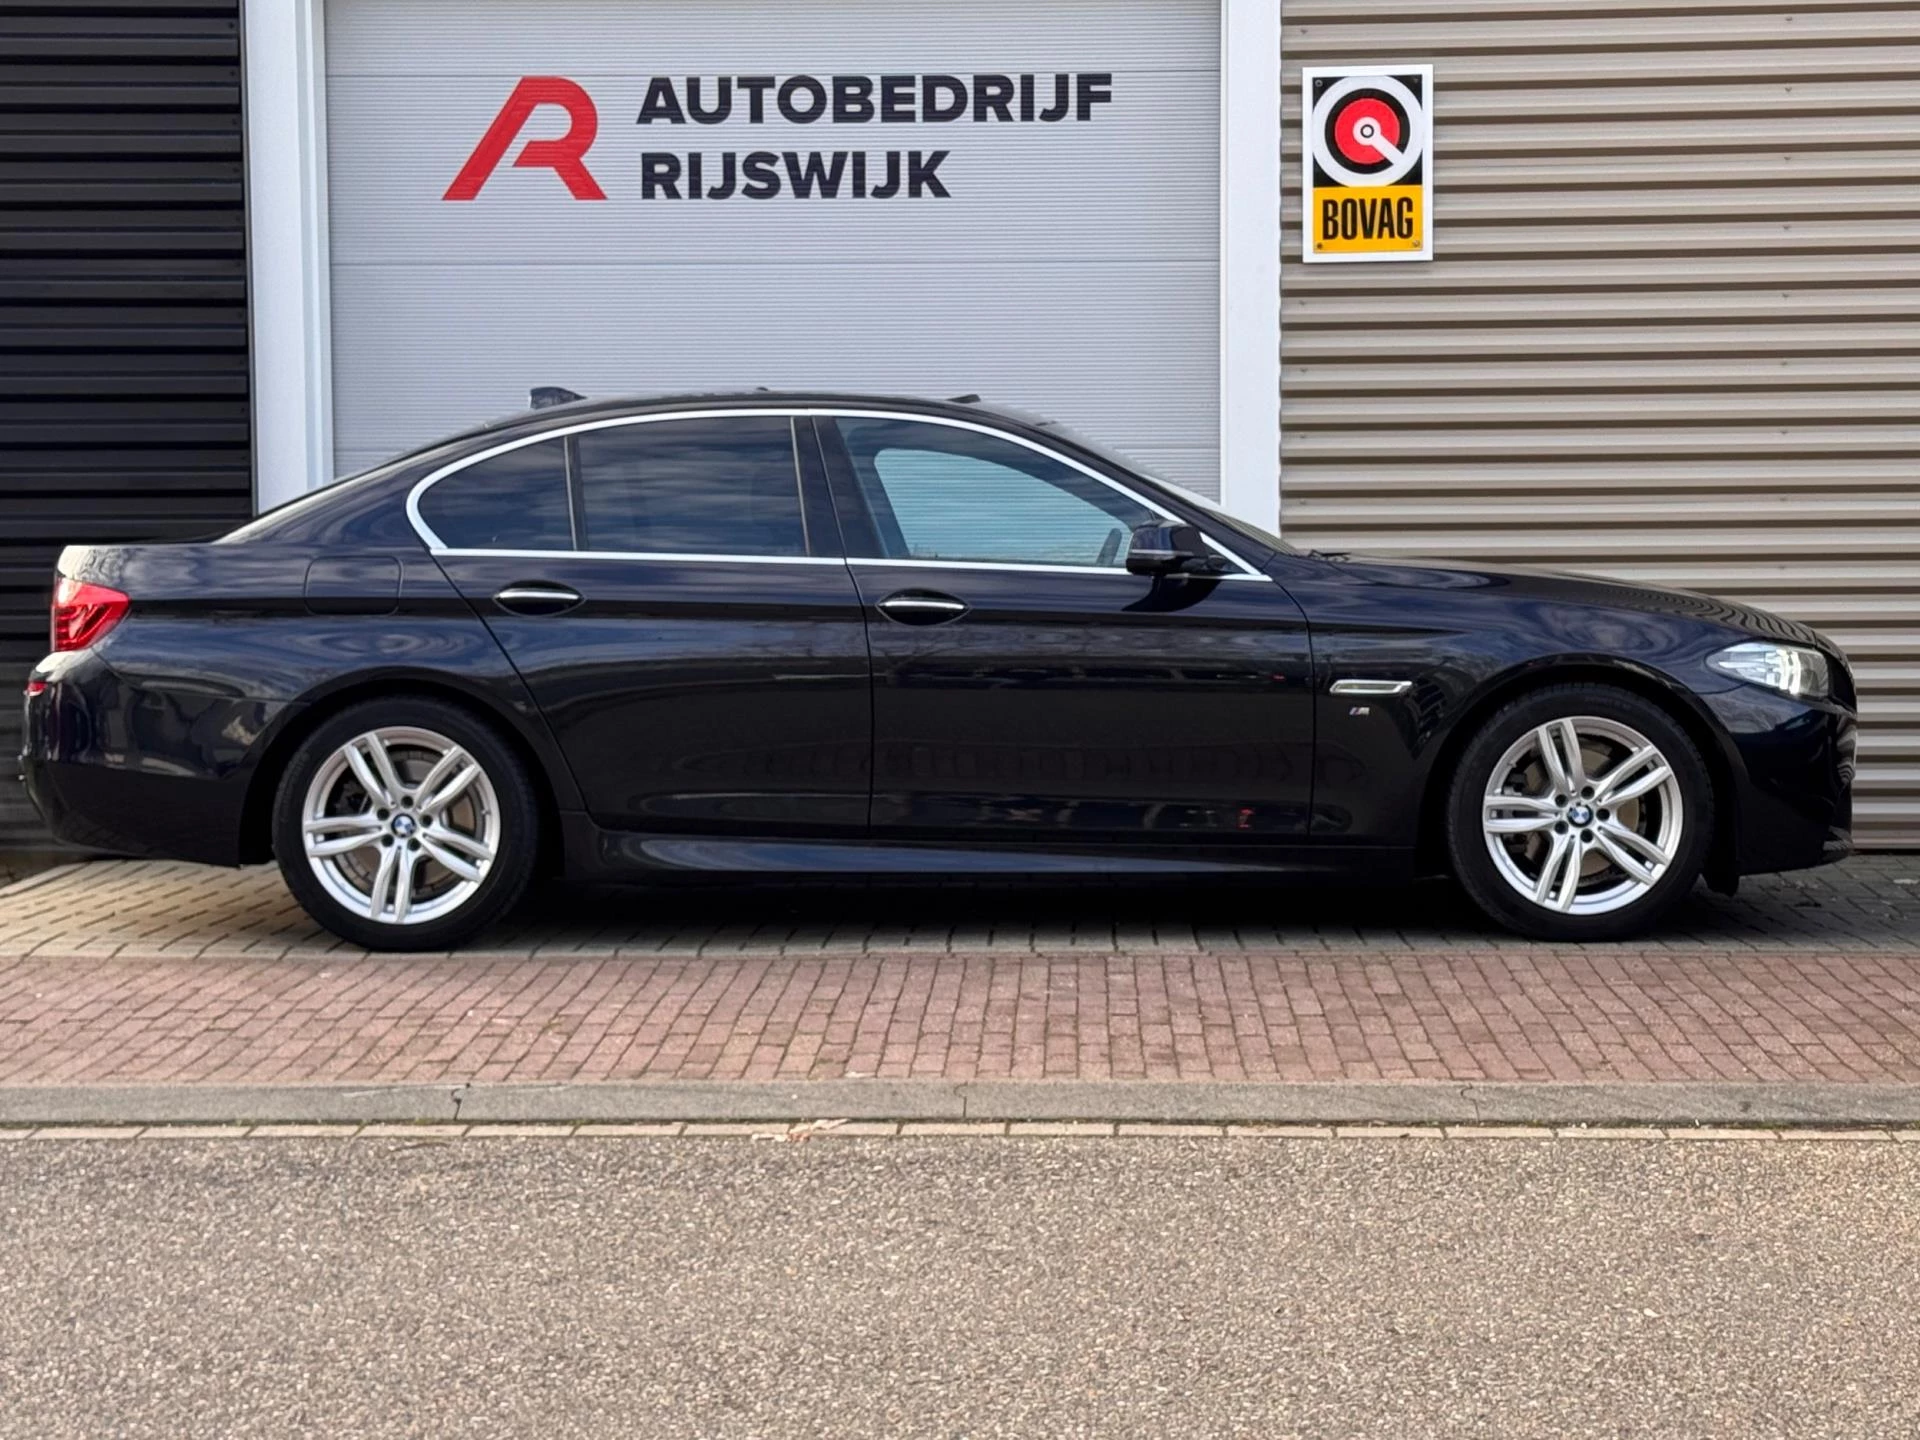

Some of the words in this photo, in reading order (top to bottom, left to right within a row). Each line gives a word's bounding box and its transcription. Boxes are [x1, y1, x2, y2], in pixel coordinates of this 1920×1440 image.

[636, 73, 1112, 124] AUTOBEDRIJF
[641, 150, 951, 200] RIJSWIJK
[1322, 196, 1413, 240] BOVAG
